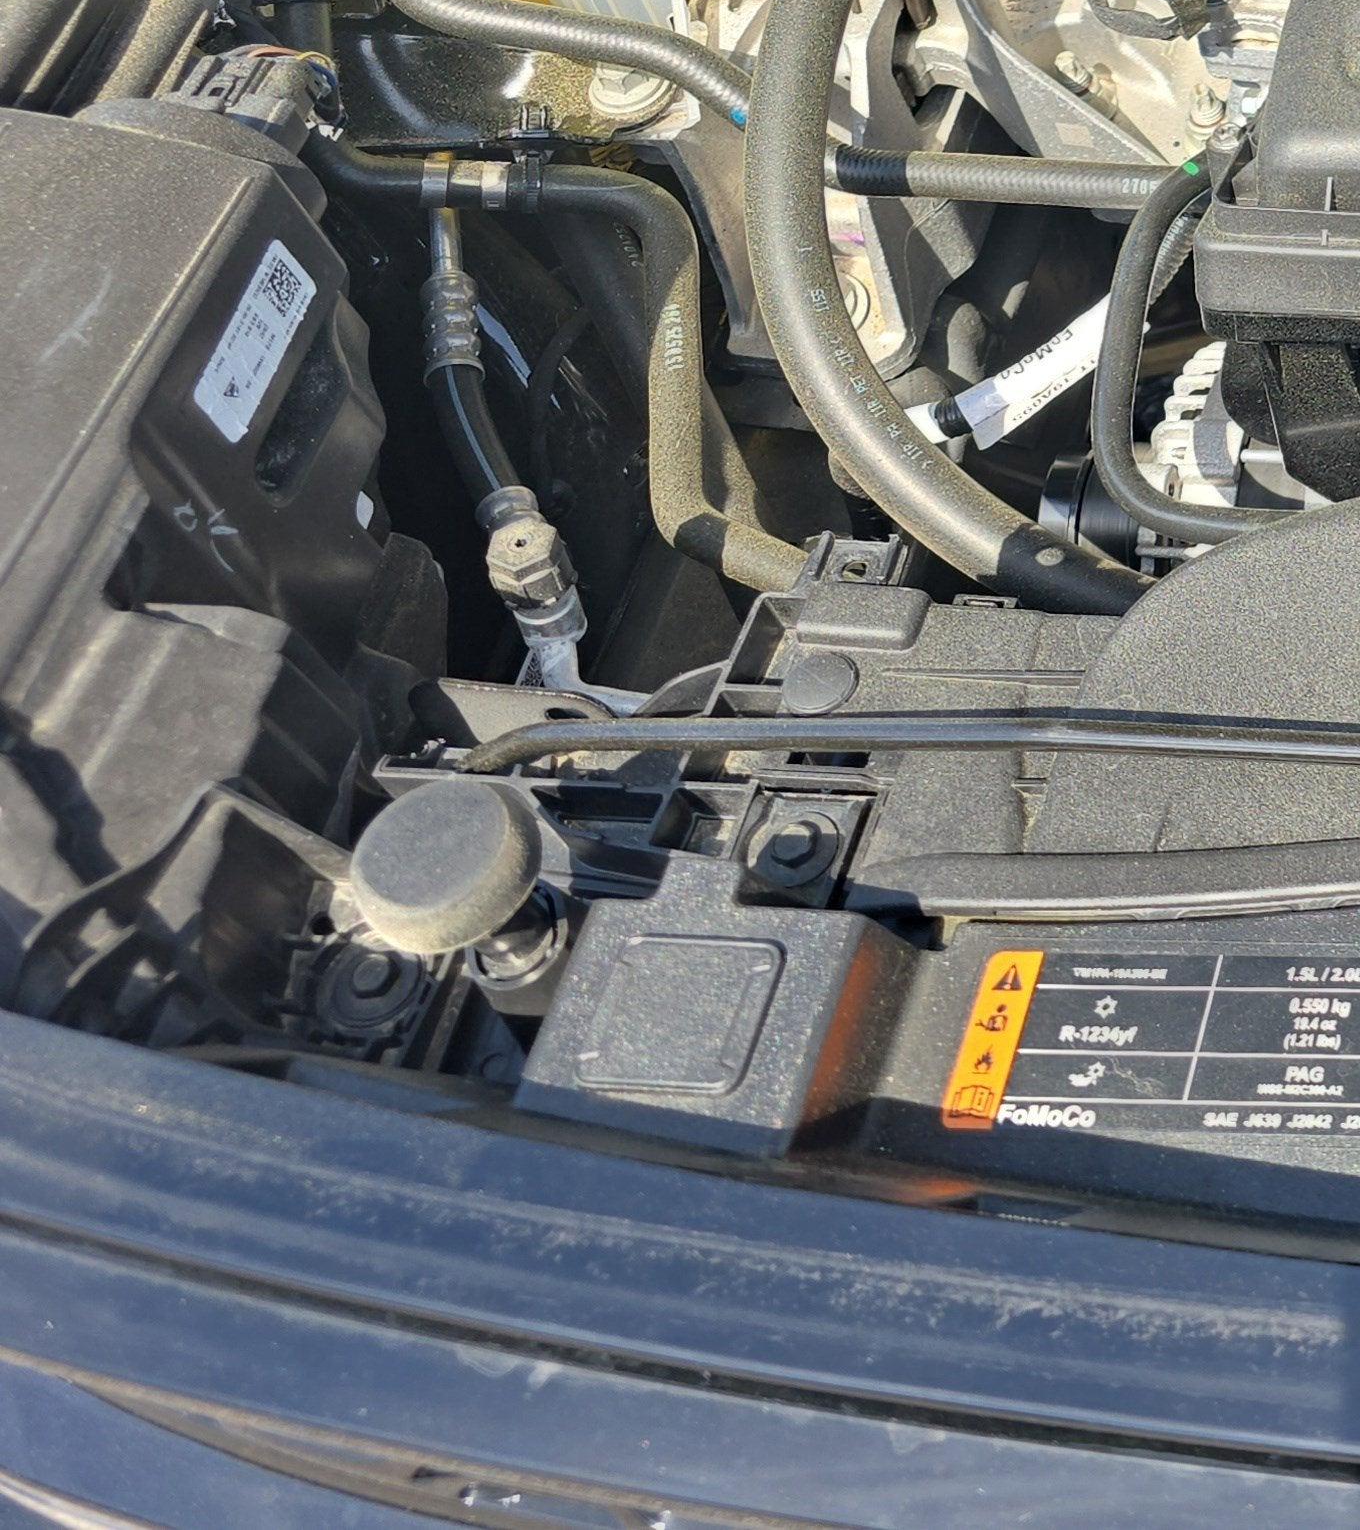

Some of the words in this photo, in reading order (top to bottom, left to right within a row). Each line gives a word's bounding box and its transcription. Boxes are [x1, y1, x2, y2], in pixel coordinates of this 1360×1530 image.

[1286, 966, 1319, 982] 1.5L
[1288, 997, 1330, 1013] 0.550
[1331, 998, 1352, 1019] kg
[1320, 1019, 1338, 1031] oz
[1058, 1024, 1139, 1047] R-1234yf
[1283, 1032, 1315, 1051] (1.21
[1315, 1033, 1342, 1051] lbs)
[1284, 1065, 1326, 1083] PAG
[996, 1103, 1097, 1128] FoMoCo
[1202, 1111, 1239, 1128] SAE
[1243, 1112, 1282, 1129] J639
[1286, 1113, 1333, 1130] J2842
